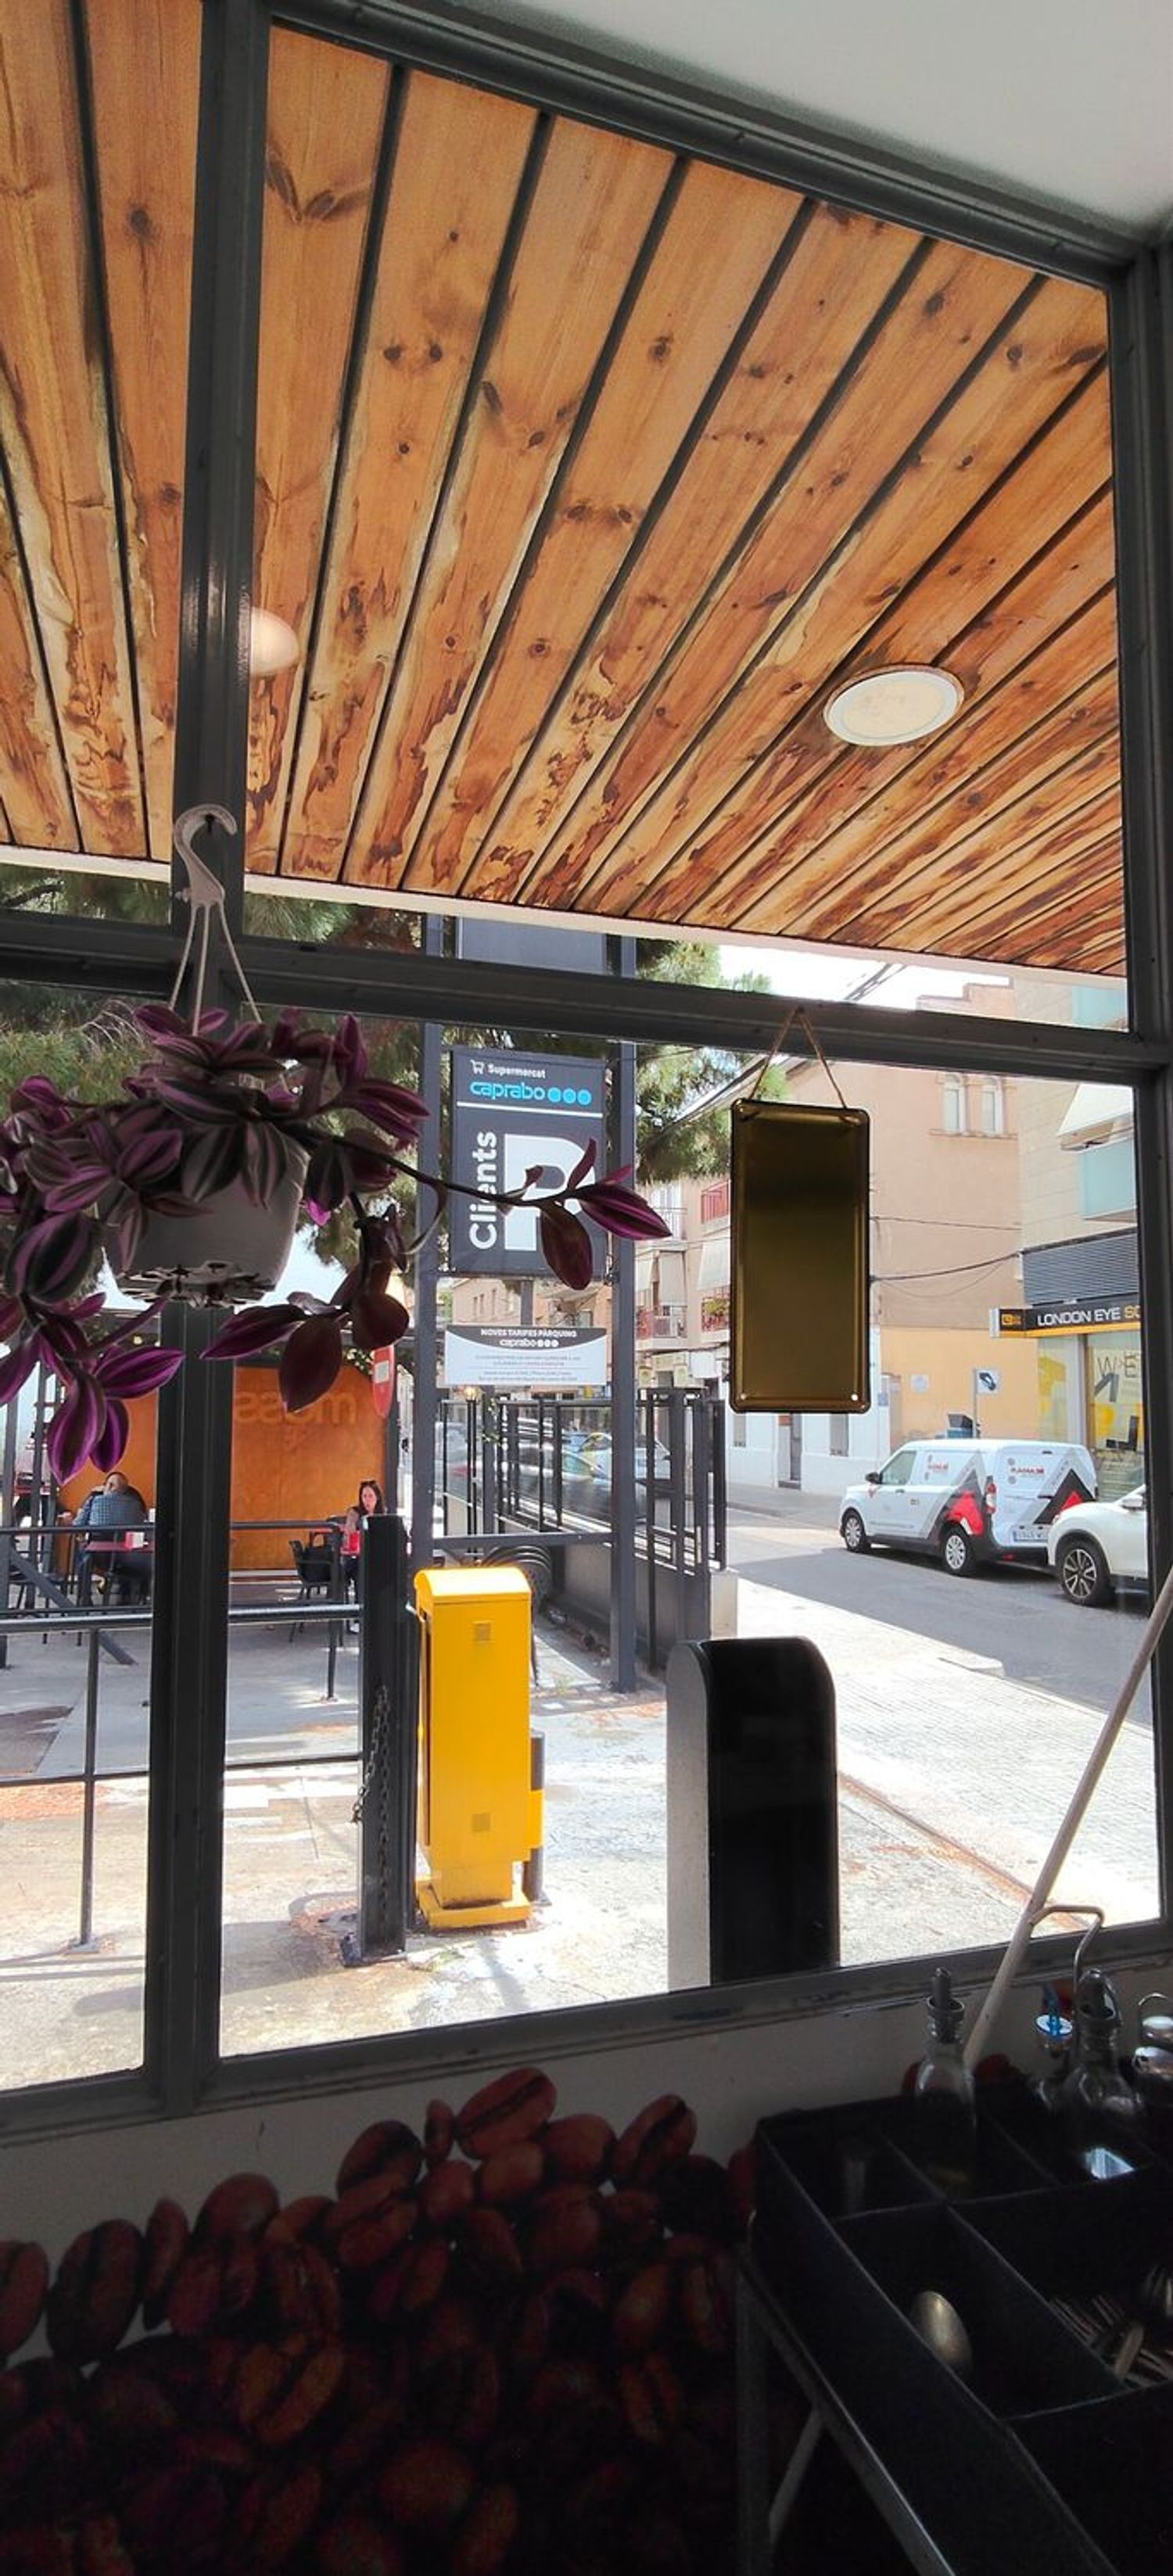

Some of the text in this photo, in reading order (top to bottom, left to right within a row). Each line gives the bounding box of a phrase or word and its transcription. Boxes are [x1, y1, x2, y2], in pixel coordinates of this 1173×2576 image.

[488, 1064, 546, 1078] Supermercat
[470, 1082, 545, 1100] caprabo
[469, 1132, 497, 1249] Clients
[504, 1133, 595, 1251] P
[1038, 1310, 1091, 1326] LONDON
[1095, 1307, 1121, 1322] EYE
[500, 1338, 536, 1347] caprabo
